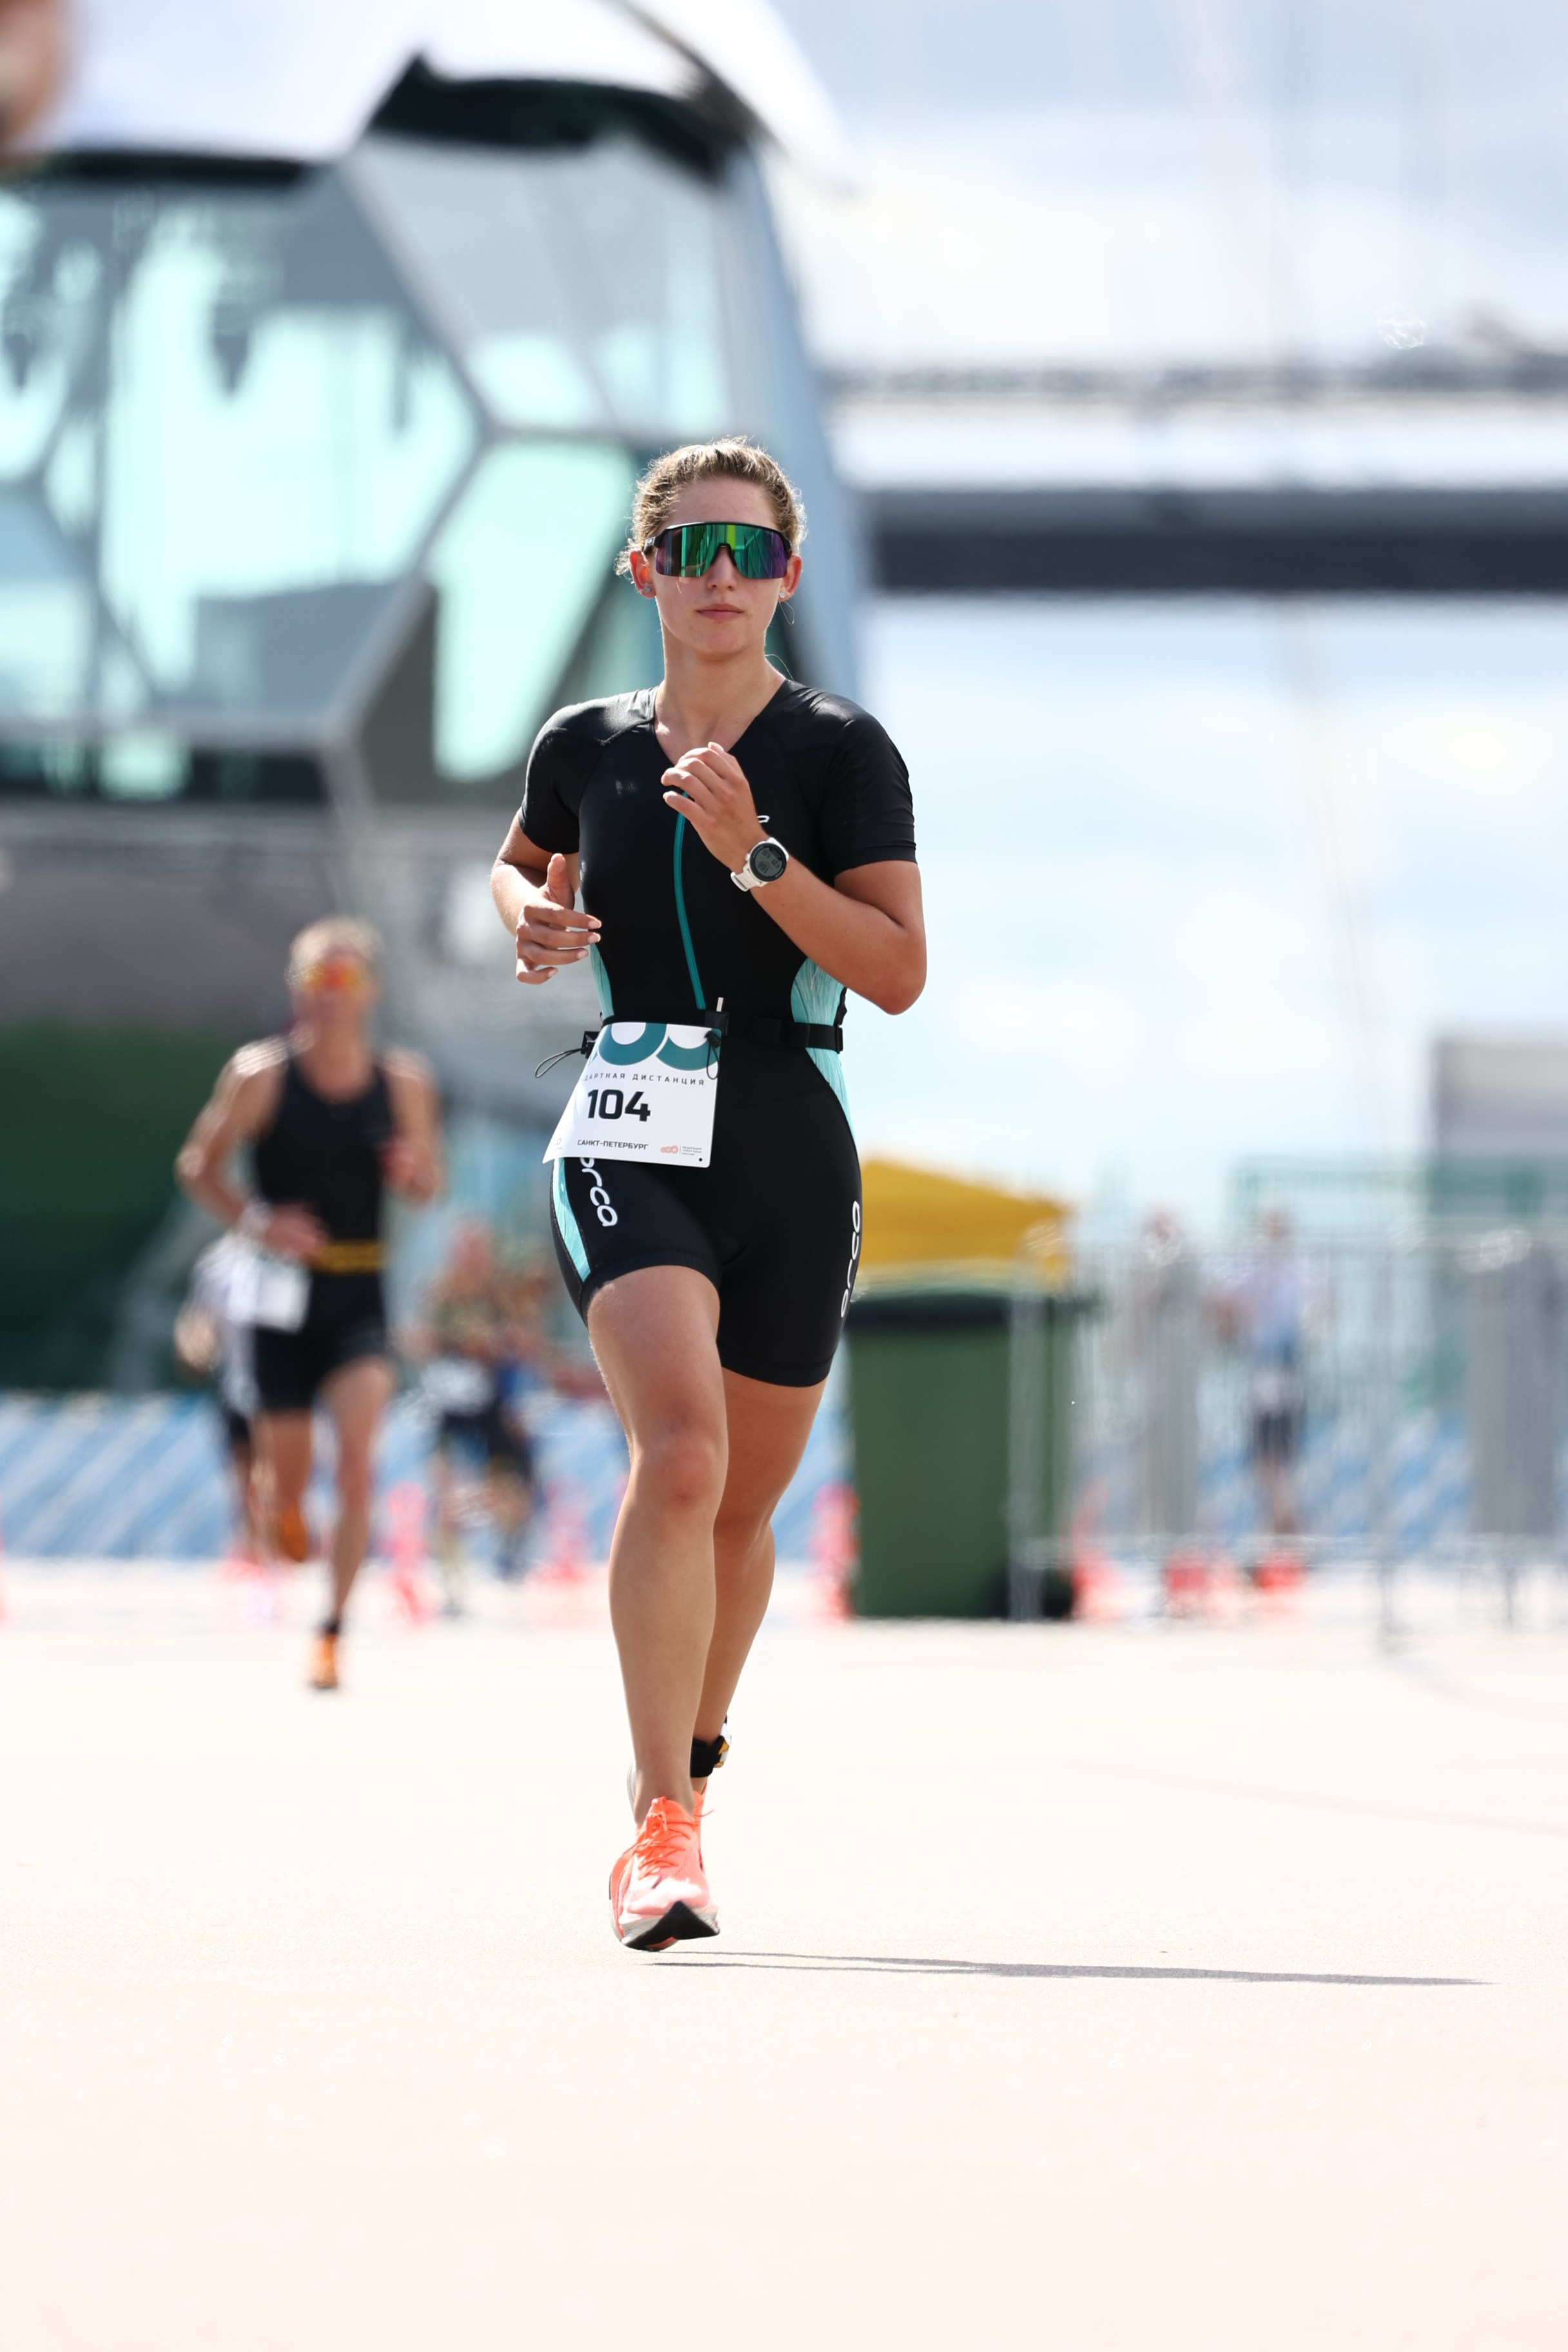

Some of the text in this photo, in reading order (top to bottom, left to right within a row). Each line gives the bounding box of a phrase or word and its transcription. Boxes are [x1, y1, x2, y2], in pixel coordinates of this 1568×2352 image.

[632, 1073, 704, 1086] ДИСТАНЦИЯ
[587, 1089, 651, 1122] 104
[577, 1139, 649, 1150] САНКТ-ПЕТЕРБУРГ
